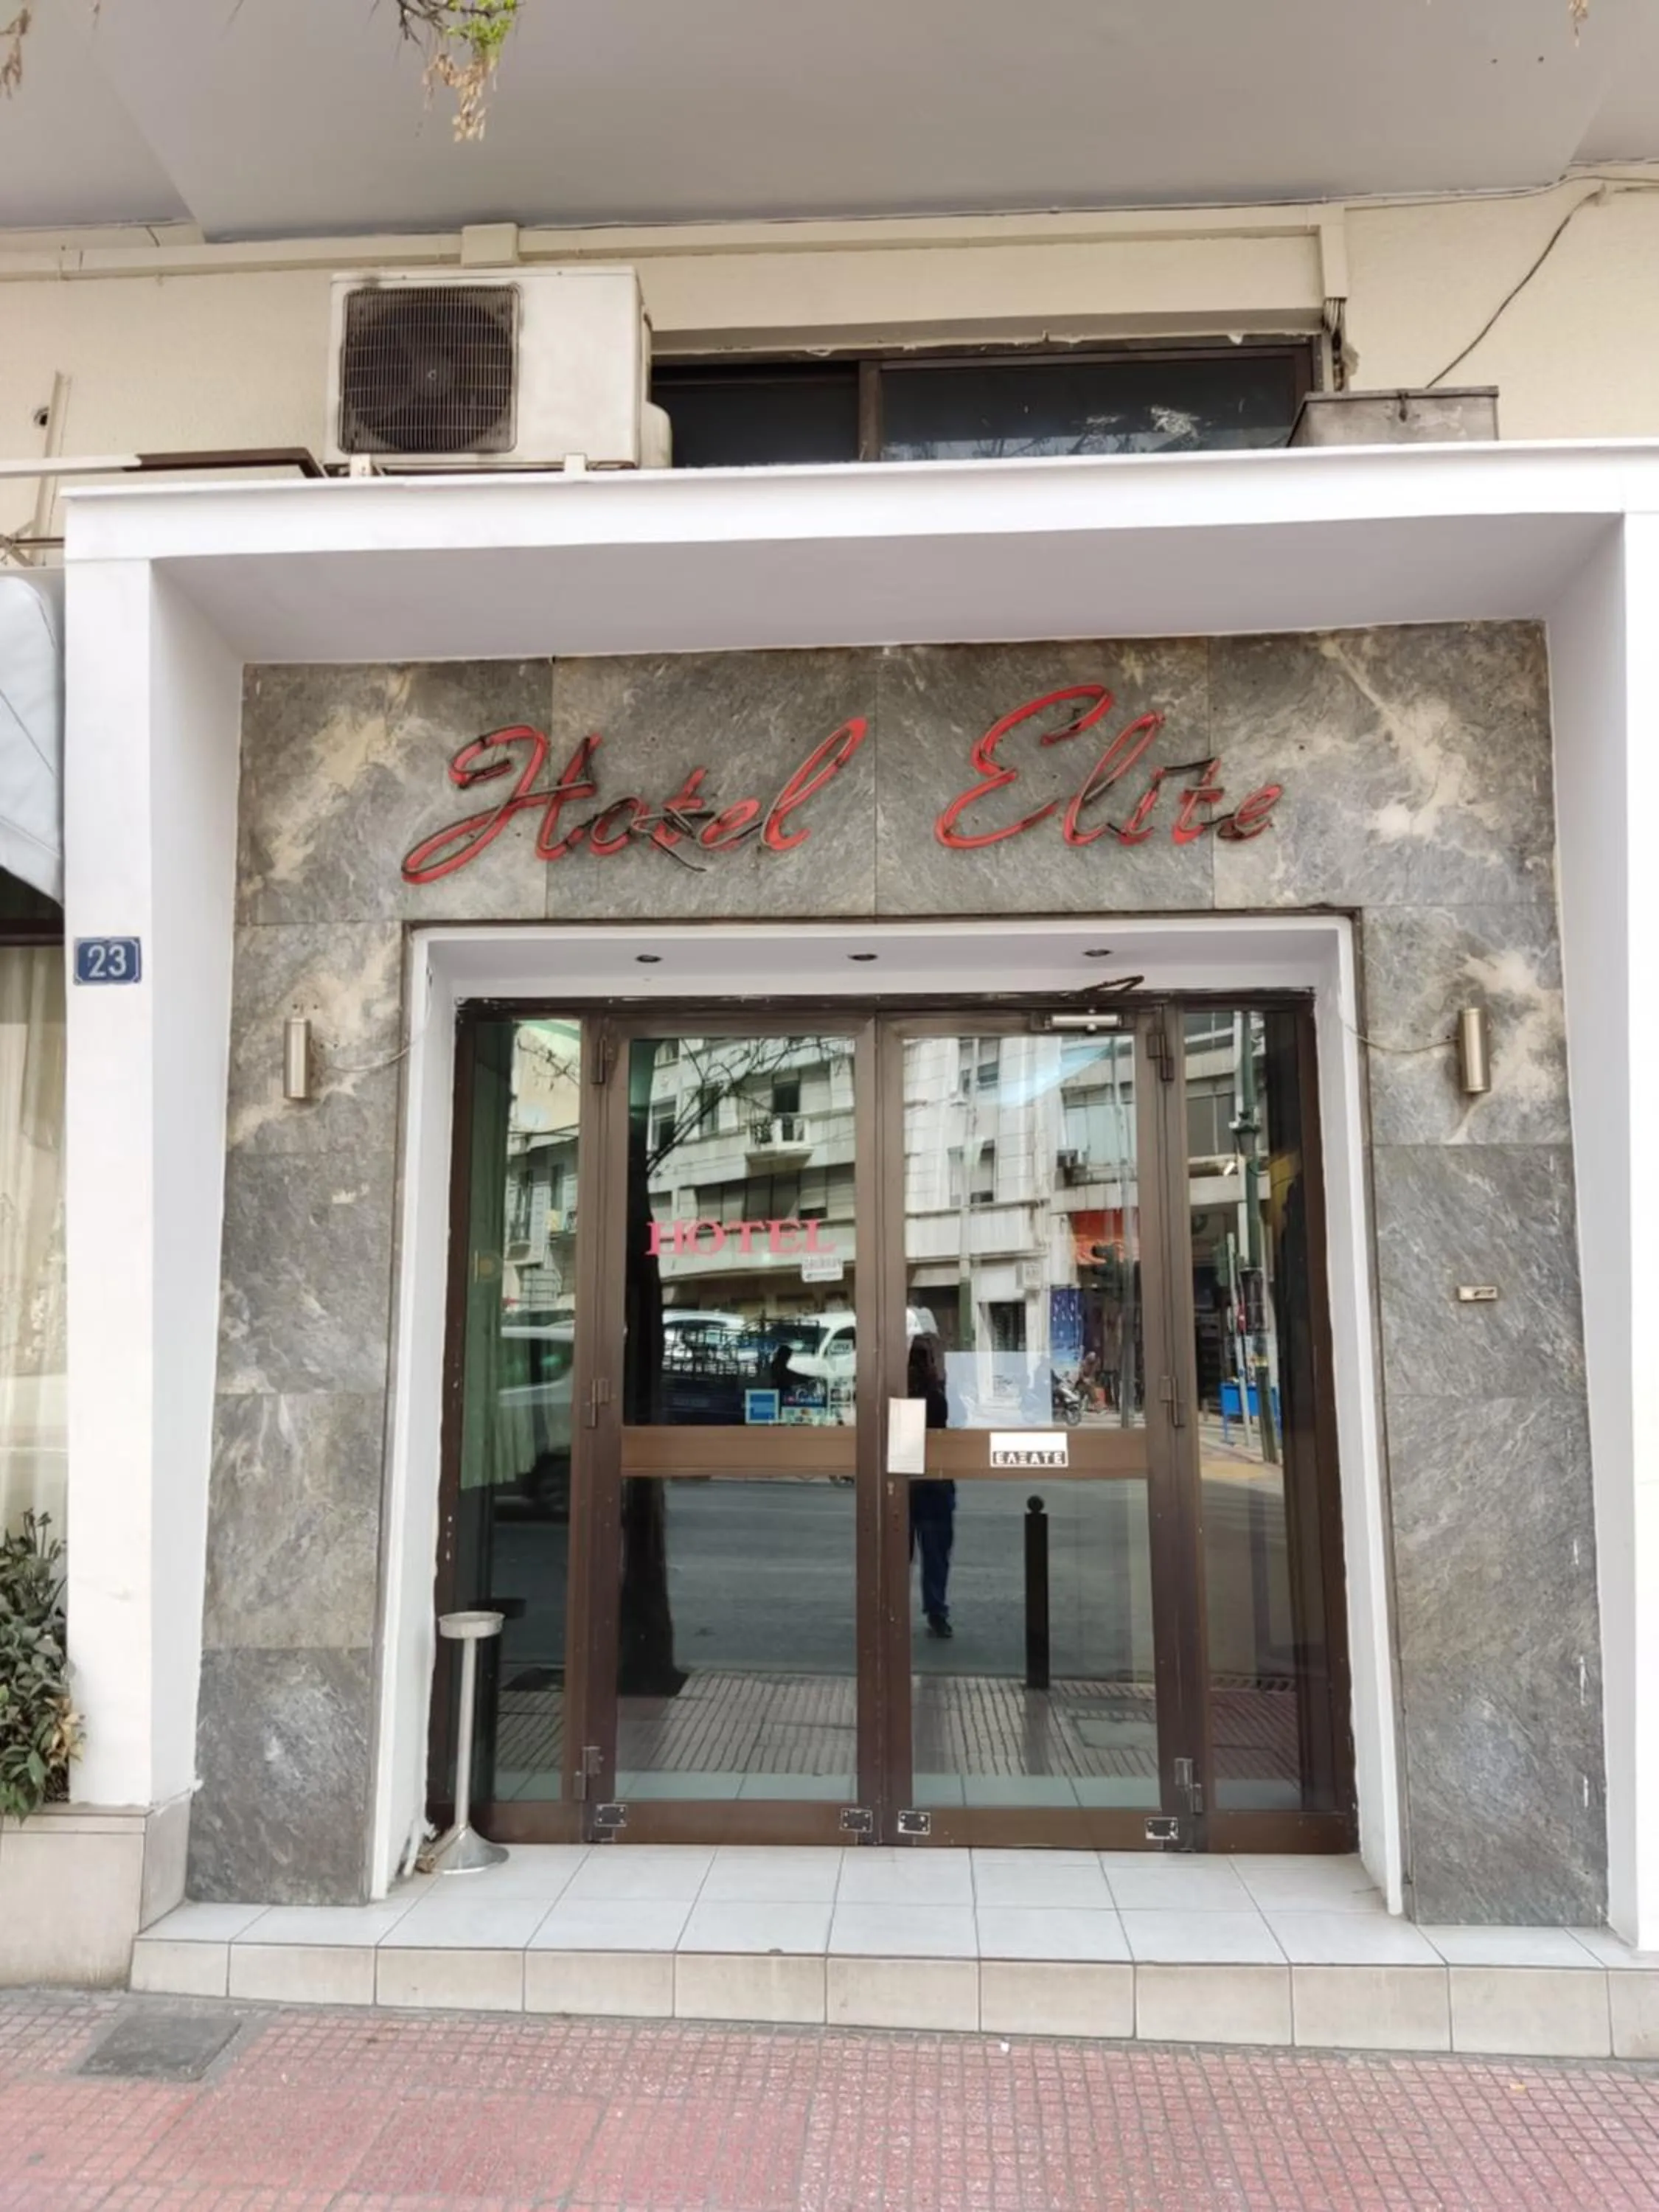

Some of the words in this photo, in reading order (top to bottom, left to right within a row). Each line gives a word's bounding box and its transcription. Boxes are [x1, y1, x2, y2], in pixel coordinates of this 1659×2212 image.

[401, 717, 869, 884] Hotel
[935, 684, 1285, 849] Elite
[88, 945, 127, 978] 23
[644, 1219, 837, 1256] HOTEL
